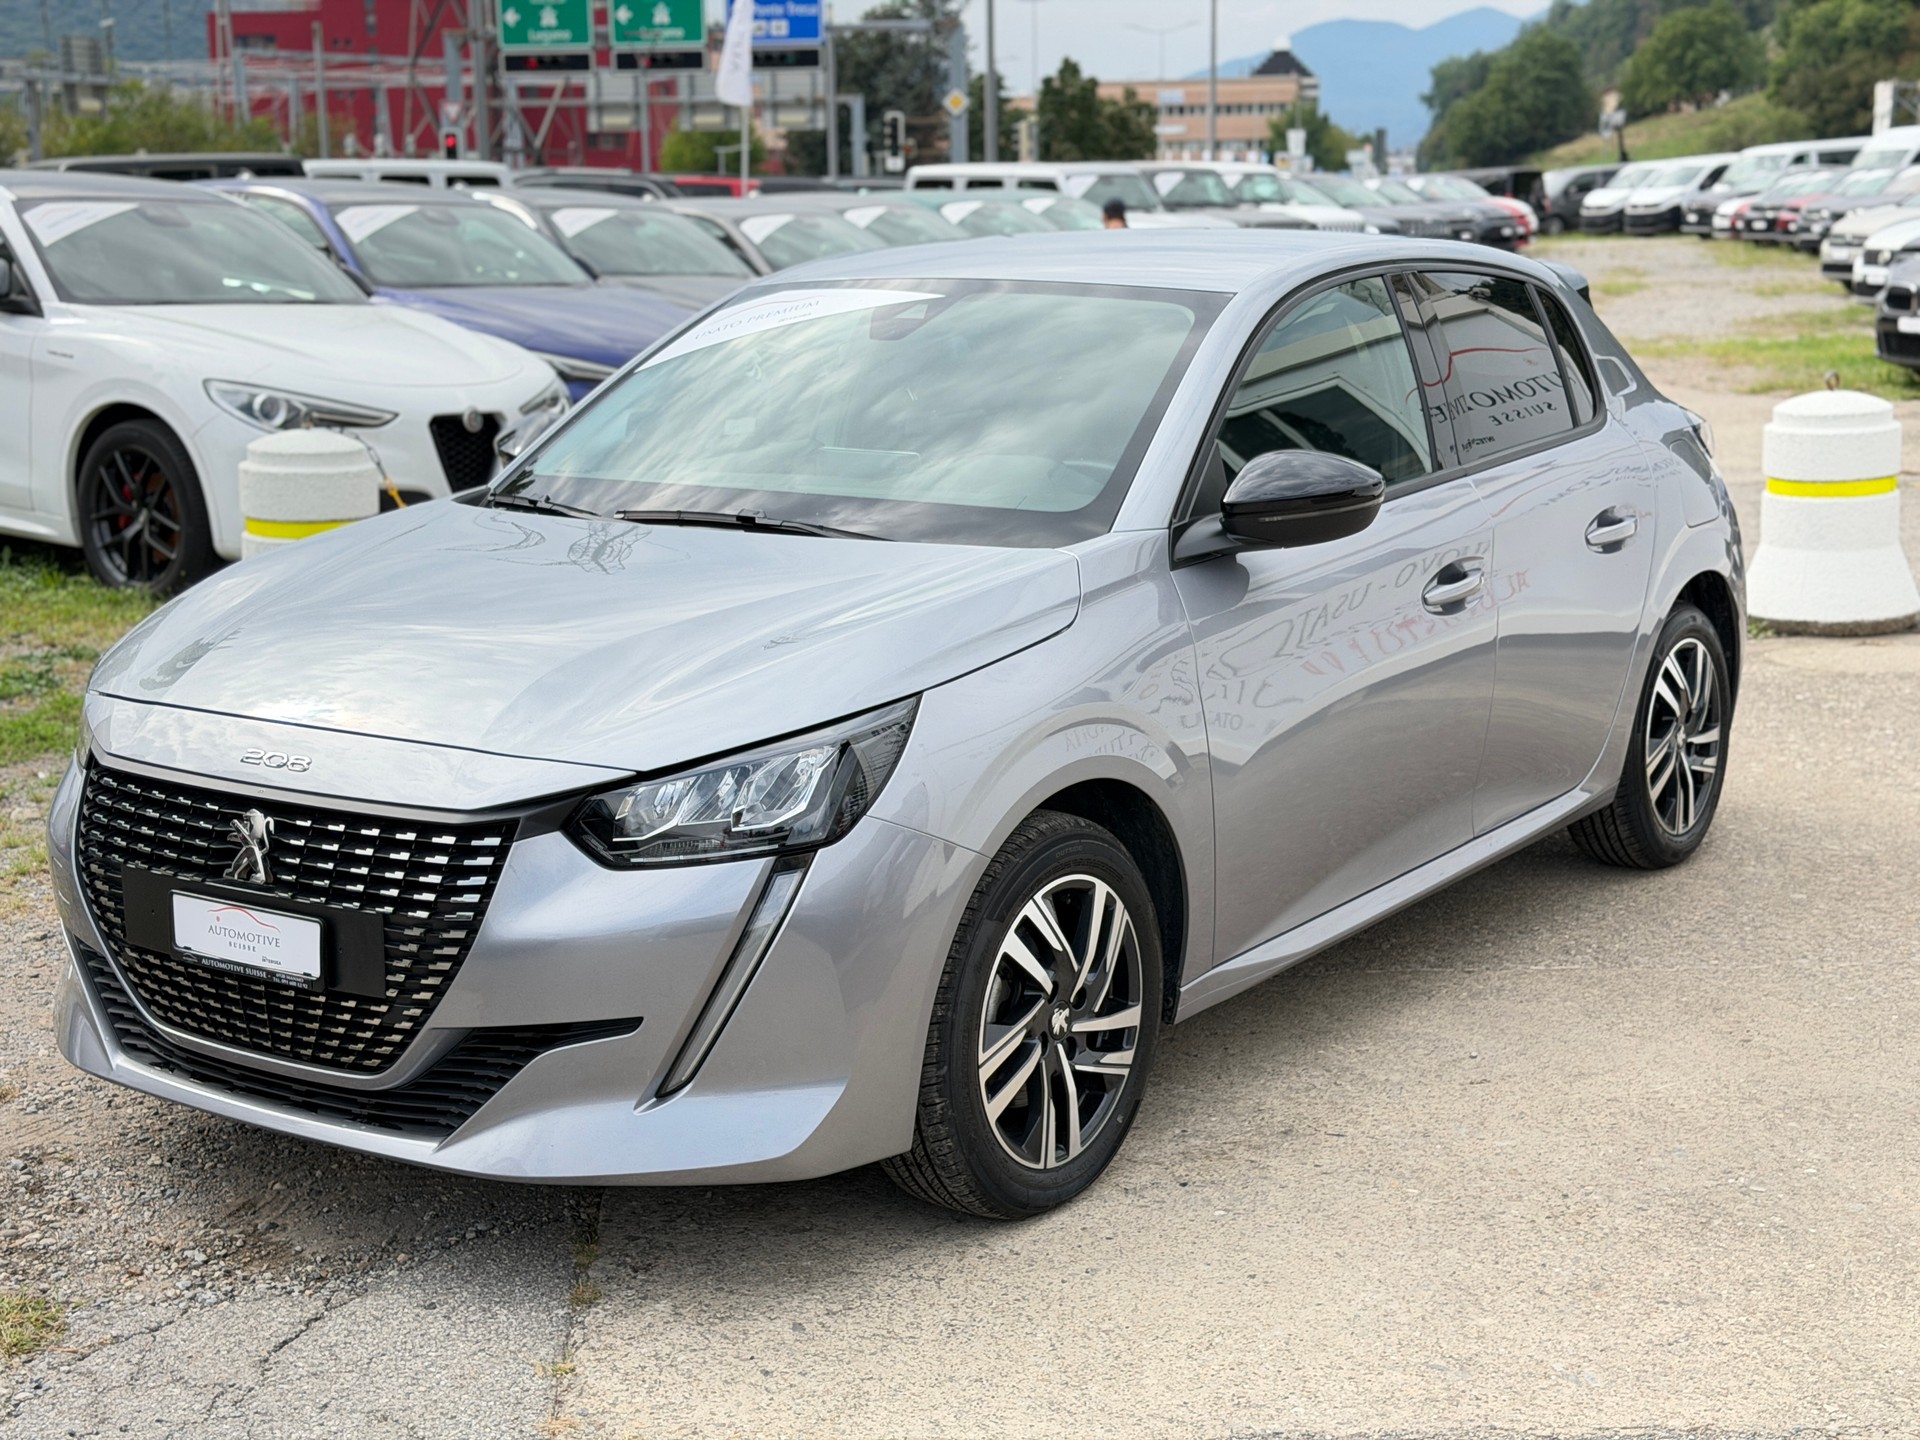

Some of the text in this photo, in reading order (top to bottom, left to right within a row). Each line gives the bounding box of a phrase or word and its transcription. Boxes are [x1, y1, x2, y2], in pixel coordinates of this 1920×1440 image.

[527, 29, 573, 44] Lugano
[747, 300, 820, 323] PREMIUM
[240, 748, 313, 773] 208
[208, 924, 281, 948] AUTOMOTIVE
[229, 941, 257, 953] SUISSE
[202, 958, 245, 974] AUTOMOTIVE
[245, 967, 267, 979] SUISSE
